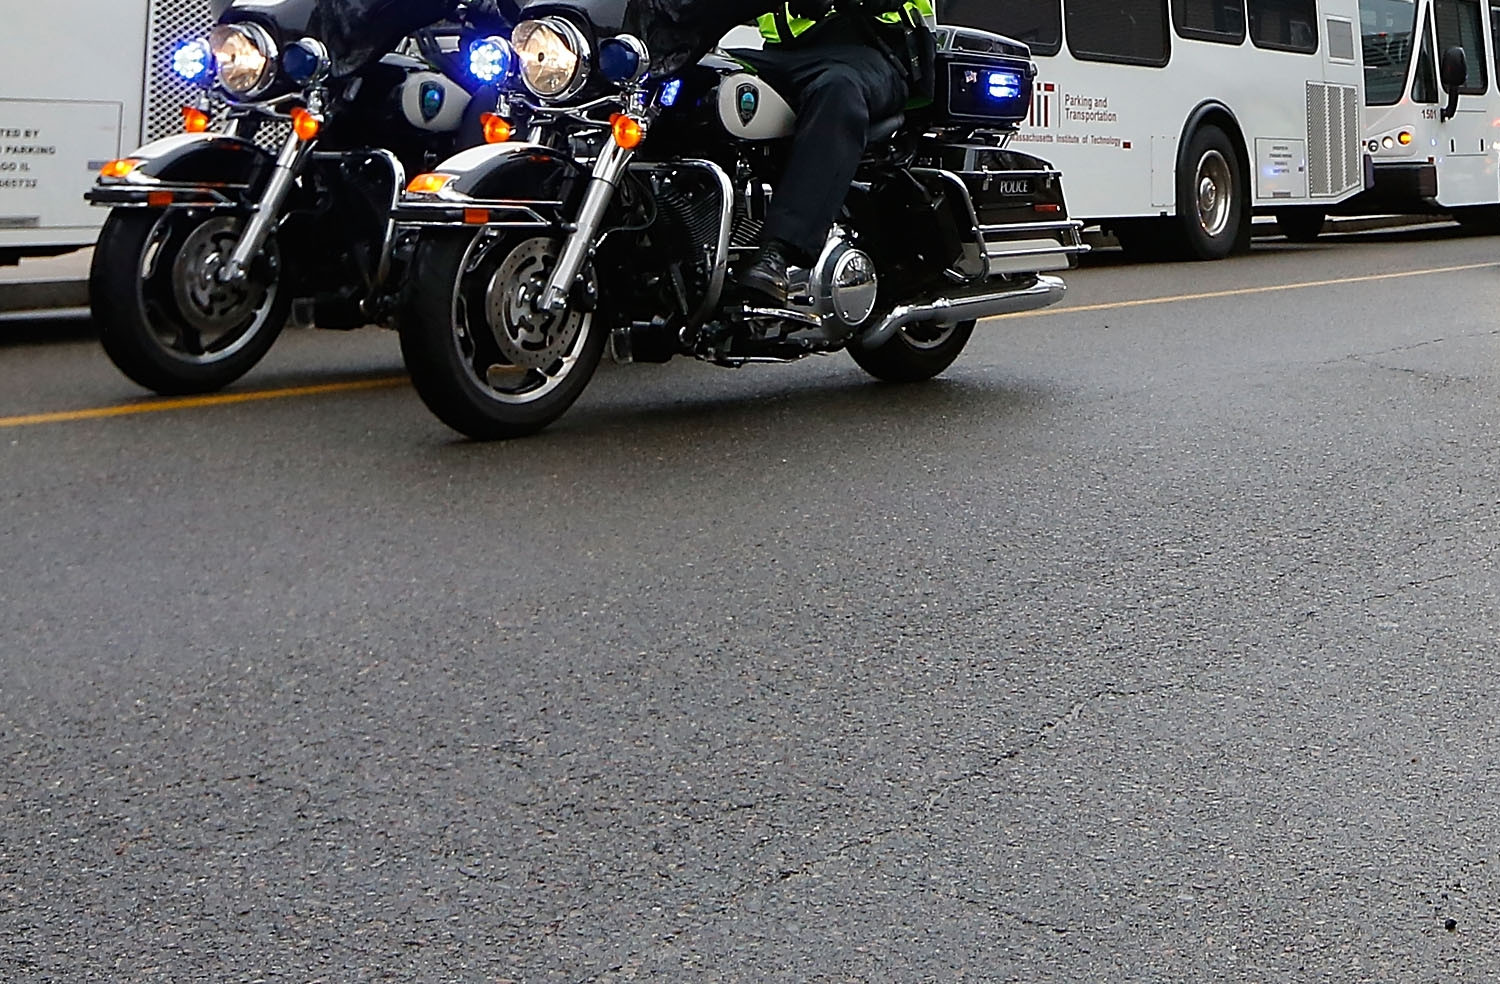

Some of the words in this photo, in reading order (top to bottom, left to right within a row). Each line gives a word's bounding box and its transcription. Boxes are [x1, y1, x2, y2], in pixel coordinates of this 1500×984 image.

[1065, 94, 1092, 110] Parking
[1094, 97, 1107, 108] and
[1065, 108, 1117, 123] Transportation
[1056, 134, 1079, 143] Institute
[1091, 135, 1121, 147] Technology
[6, 146, 56, 155] PARKING
[1000, 180, 1028, 193] POLICE
